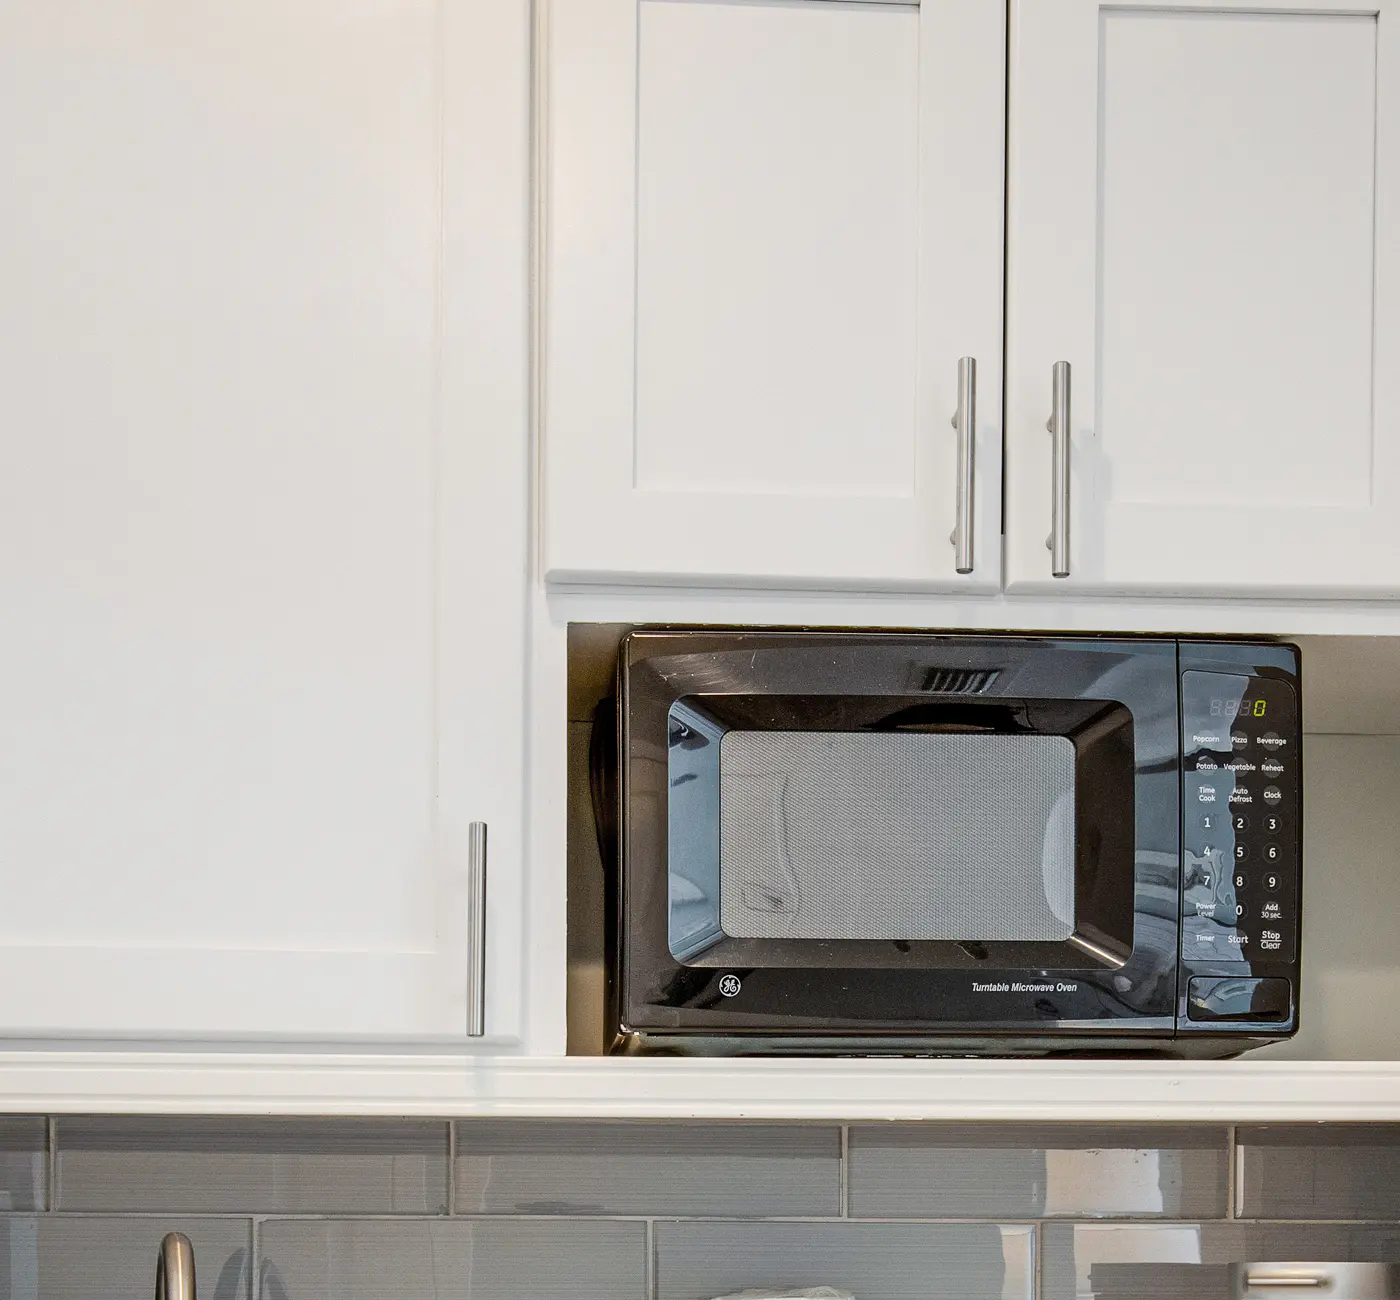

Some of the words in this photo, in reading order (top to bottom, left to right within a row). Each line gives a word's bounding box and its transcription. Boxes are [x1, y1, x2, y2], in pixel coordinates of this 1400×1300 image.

[1257, 738, 1286, 746] Beverage
[1205, 818, 1210, 827] 1
[1237, 818, 1244, 829] 2
[1269, 819, 1276, 829] 3
[1204, 847, 1211, 856] 4
[1237, 847, 1243, 857] 5
[1269, 848, 1276, 858] 6
[1204, 876, 1210, 886] 7
[1236, 877, 1243, 886] 8
[1269, 877, 1276, 887] 9
[1236, 905, 1242, 915] 0
[1262, 931, 1280, 940] Stop
[972, 983, 1009, 991] Turntable
[1011, 983, 1054, 992] Microwave
[1056, 983, 1077, 991] Oven
